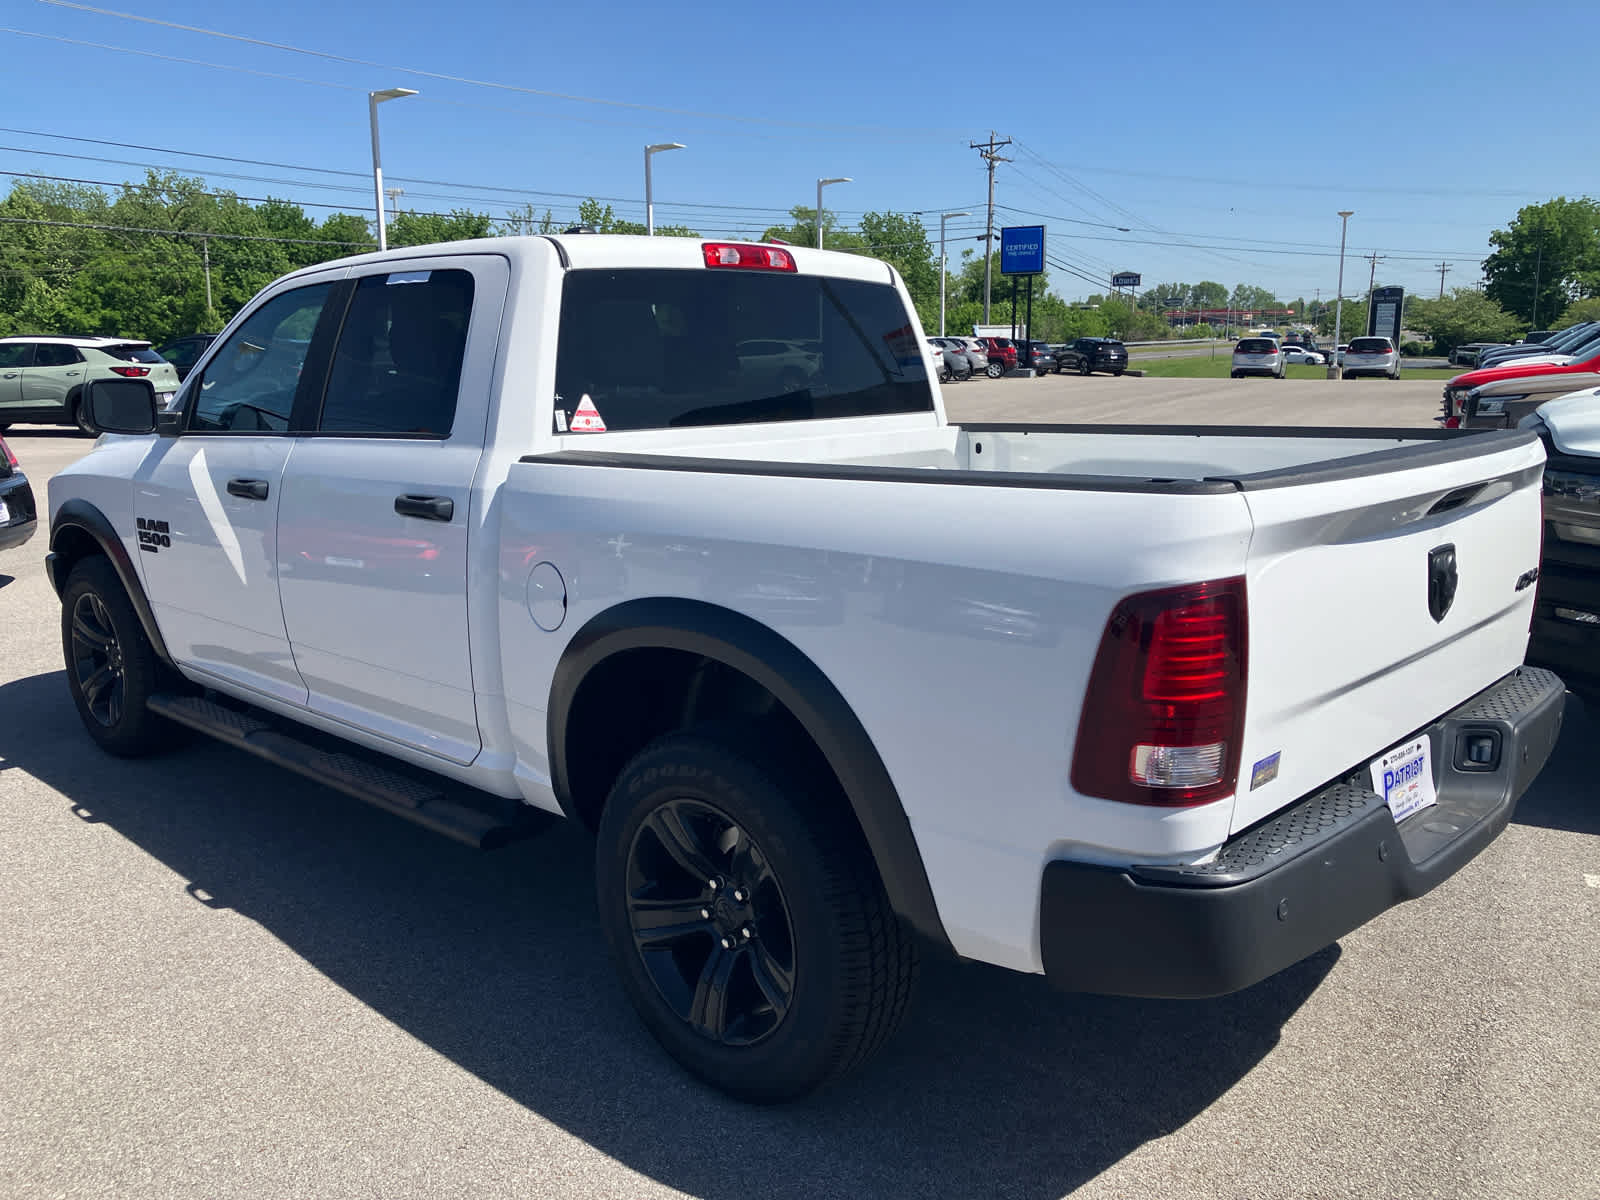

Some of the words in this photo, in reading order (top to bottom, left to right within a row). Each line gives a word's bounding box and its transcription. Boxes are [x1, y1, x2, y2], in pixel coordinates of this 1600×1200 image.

[1005, 243, 1038, 251] CERTIFIED
[136, 517, 169, 534] RAM
[138, 530, 170, 548] 1500
[1384, 756, 1424, 801] PATRIOT
